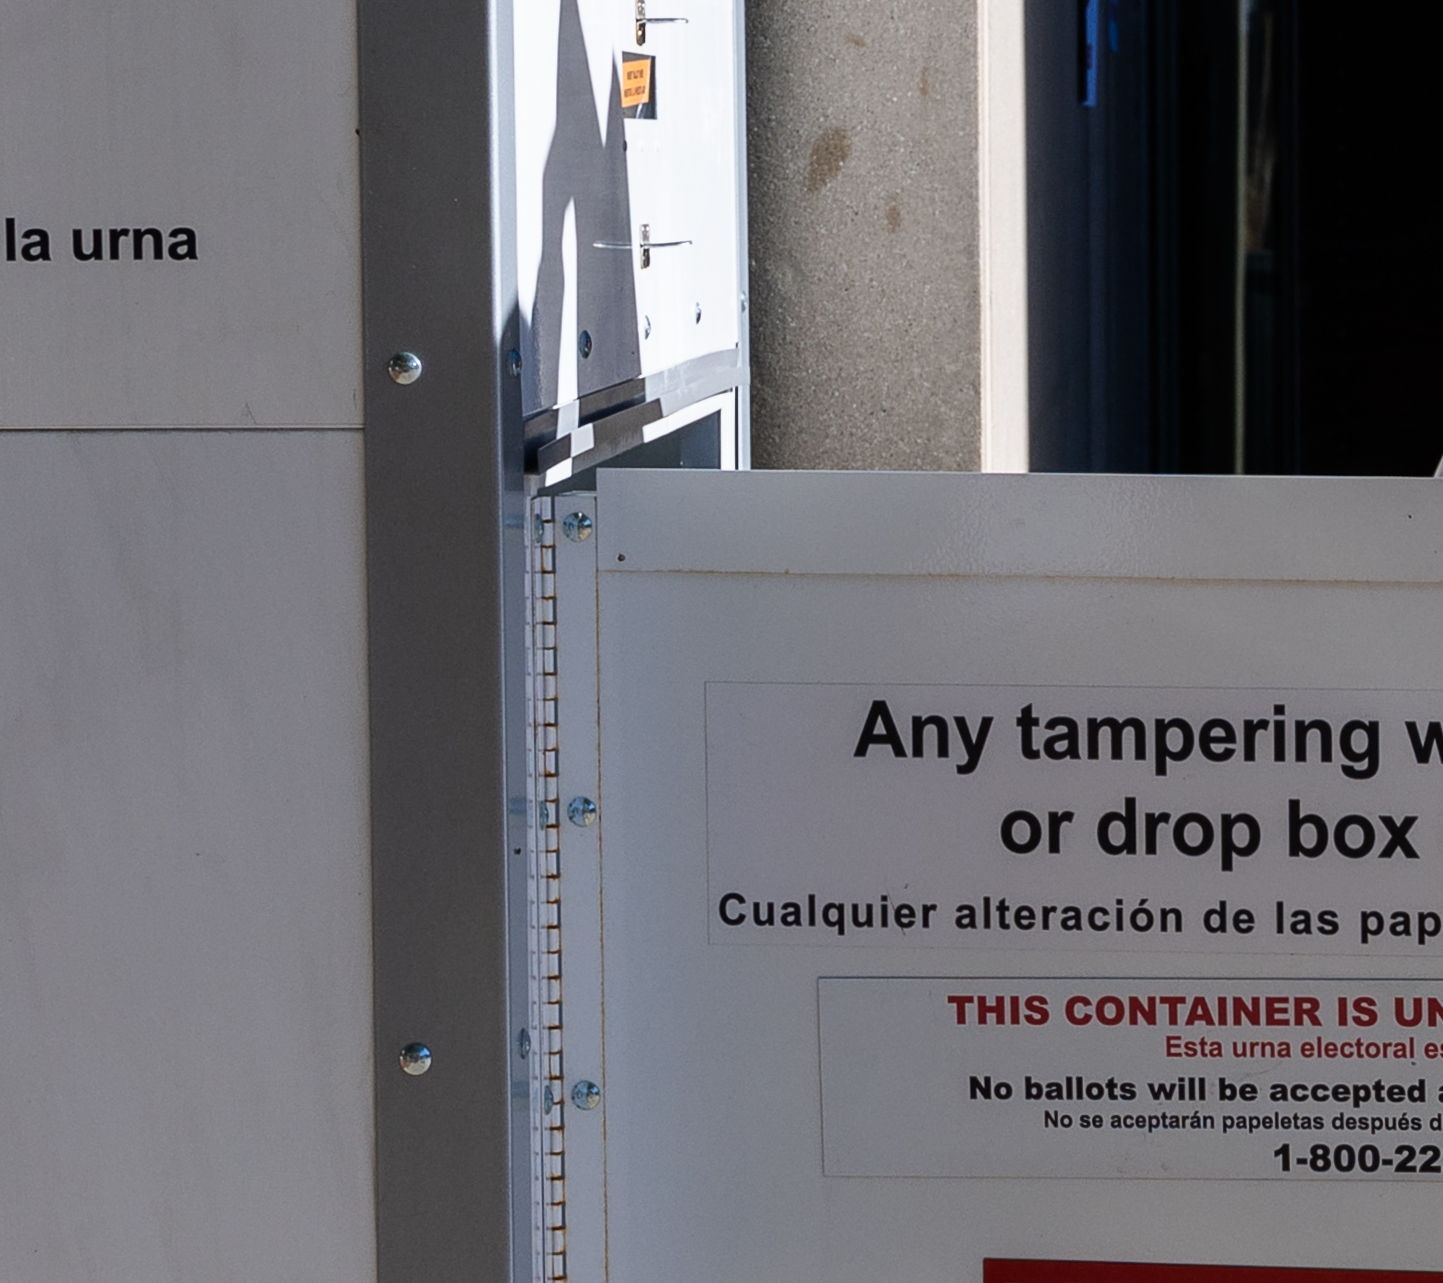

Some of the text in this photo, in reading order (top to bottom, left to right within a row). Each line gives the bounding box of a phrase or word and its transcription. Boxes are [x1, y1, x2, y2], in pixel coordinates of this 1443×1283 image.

[6, 218, 51, 261] la
[73, 228, 198, 261] urna
[854, 700, 993, 774] Any
[1016, 703, 1379, 779] tampering
[1001, 810, 1074, 854] or
[1097, 797, 1260, 871] drop
[1289, 799, 1419, 859] box
[719, 893, 937, 935] Cualquier
[955, 897, 1182, 932] alteración
[1204, 901, 1254, 934] de
[1277, 901, 1339, 935] las
[948, 996, 1049, 1025] THIS
[1065, 996, 1322, 1026] CONTAINER
[1338, 997, 1377, 1026] IS
[1166, 1036, 1222, 1057] Esta
[1233, 1042, 1291, 1058] urna
[1301, 1036, 1414, 1058] electoral
[970, 1076, 1012, 1099] No
[1025, 1076, 1136, 1100] ballots
[1148, 1077, 1205, 1100] will
[1219, 1078, 1258, 1101] be
[1270, 1079, 1425, 1108] accepted
[1045, 1110, 1072, 1128] No
[1080, 1115, 1103, 1128] se
[1111, 1111, 1214, 1133] aceptarán
[1223, 1112, 1324, 1133] papeletas
[1332, 1113, 1422, 1134] después
